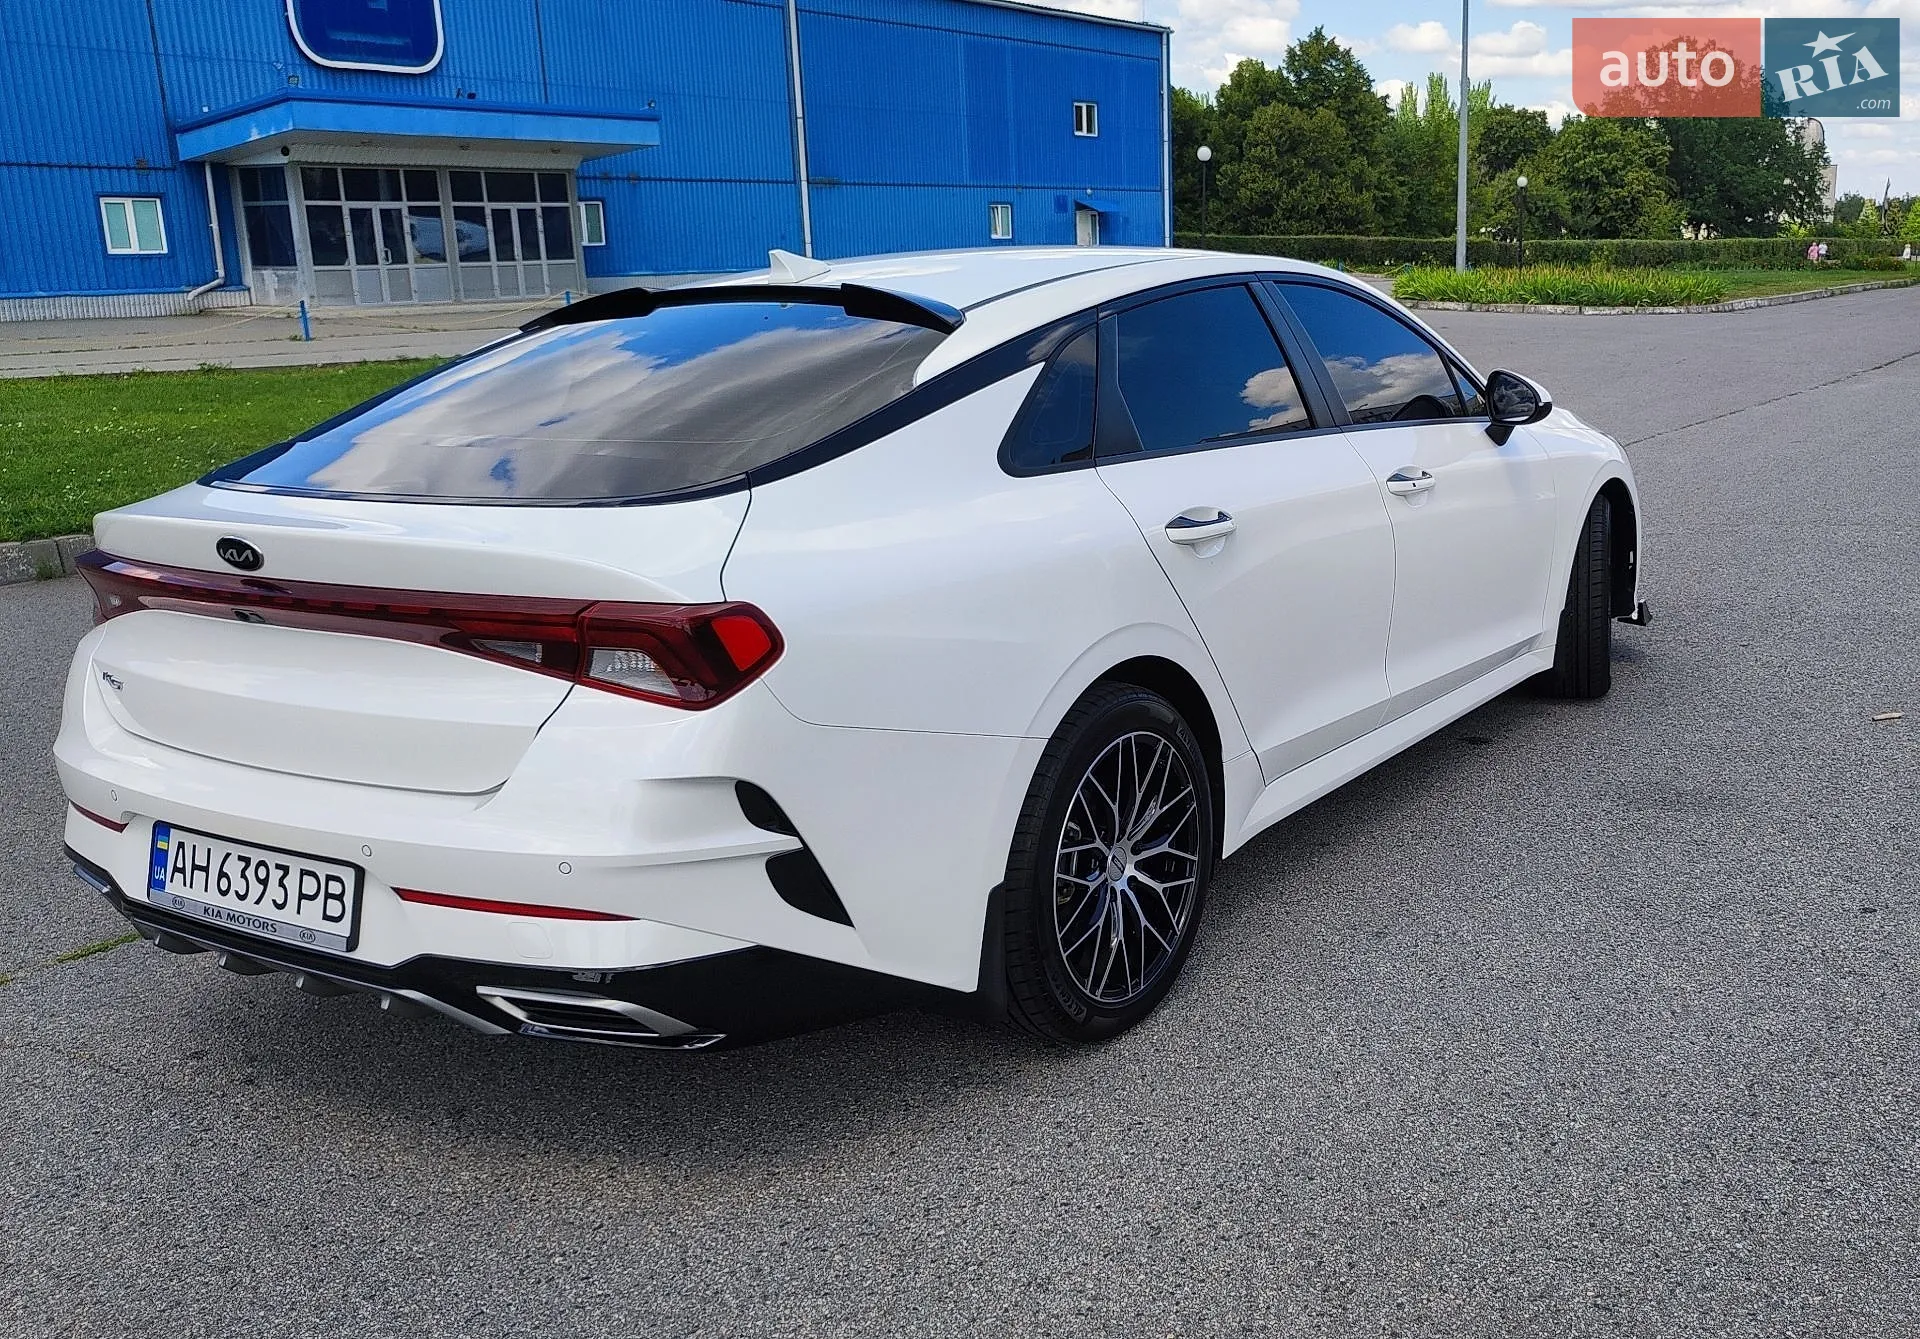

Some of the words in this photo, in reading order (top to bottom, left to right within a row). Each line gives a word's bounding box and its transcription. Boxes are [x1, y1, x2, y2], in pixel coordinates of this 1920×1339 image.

[154, 866, 166, 882] UA
[169, 841, 212, 893] AH
[217, 852, 290, 911] 6393
[296, 867, 346, 924] PB
[203, 905, 223, 920] KIA
[226, 912, 277, 934] MOTORS
